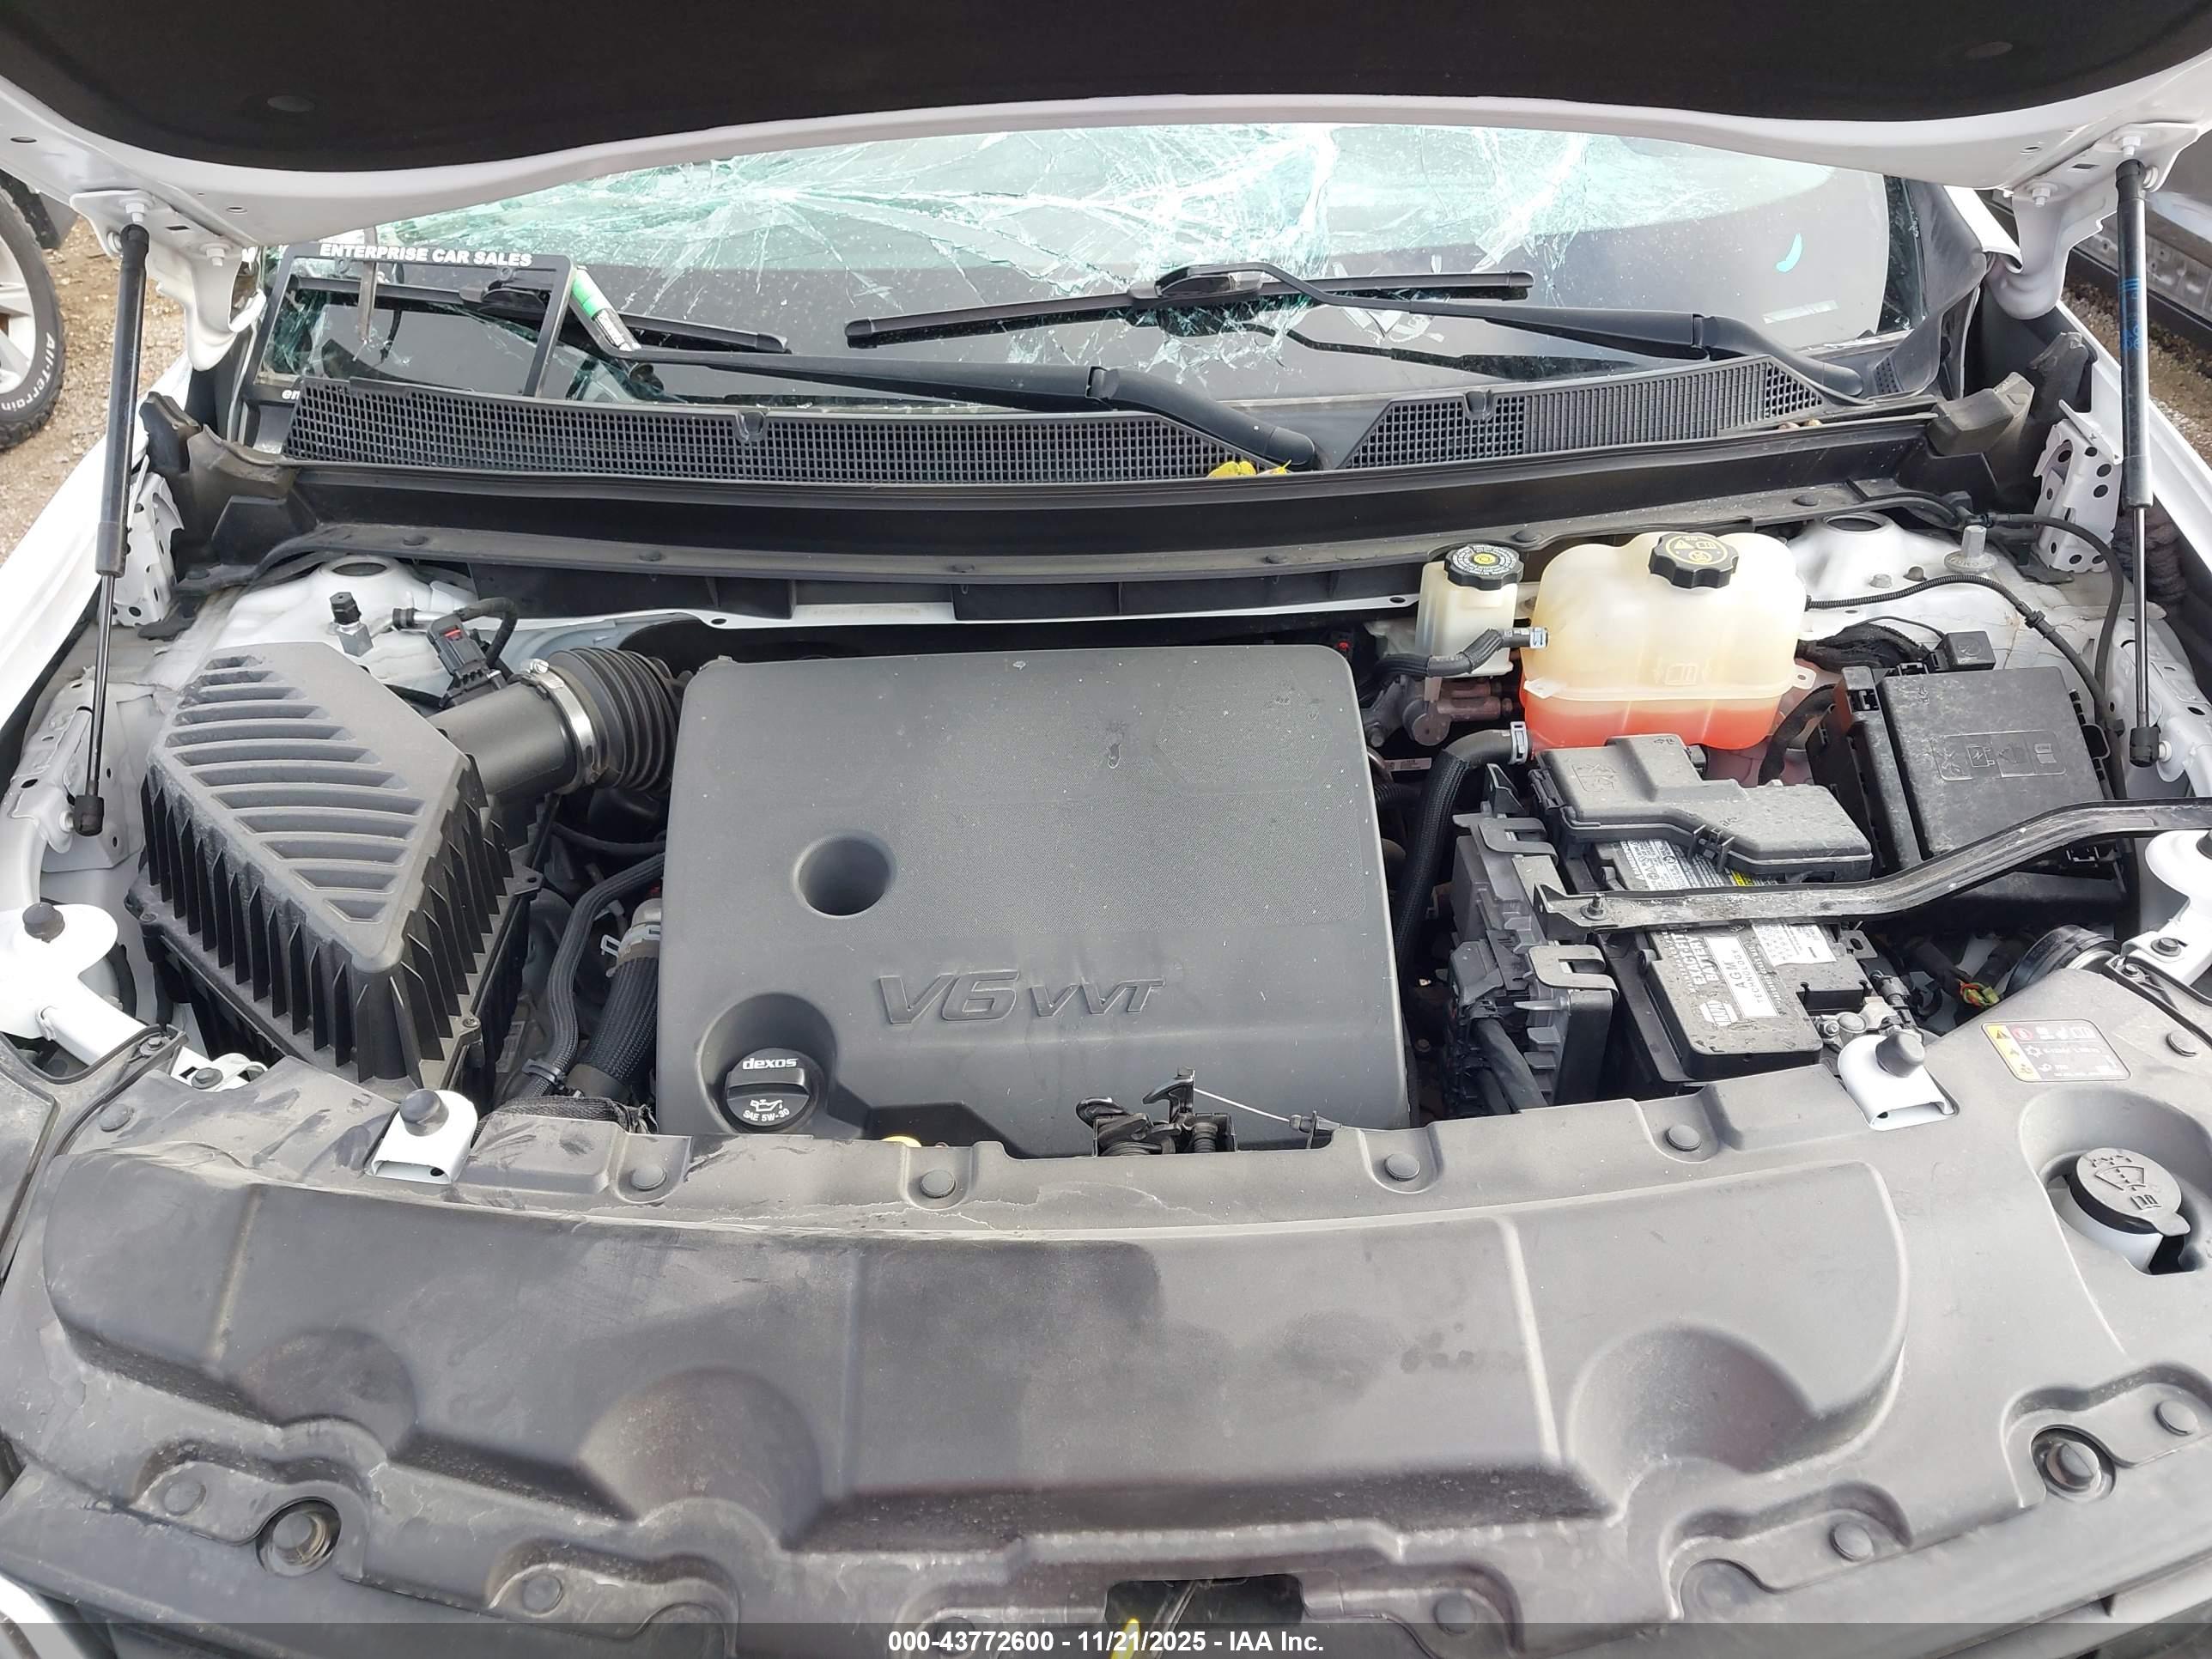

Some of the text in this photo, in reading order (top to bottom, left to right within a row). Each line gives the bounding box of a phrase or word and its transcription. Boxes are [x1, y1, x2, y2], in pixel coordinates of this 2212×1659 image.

[319, 244, 533, 267] ENTERPRISE CAR SALES
[1685, 935, 1720, 981] BATTERY
[1723, 960, 1749, 989] AGM
[1730, 947, 1765, 1003] TECHNOLOGY
[878, 969, 1165, 1024] V6 VVT
[742, 1058, 799, 1070] dexos
[743, 1108, 790, 1121] SAE 5W-30
